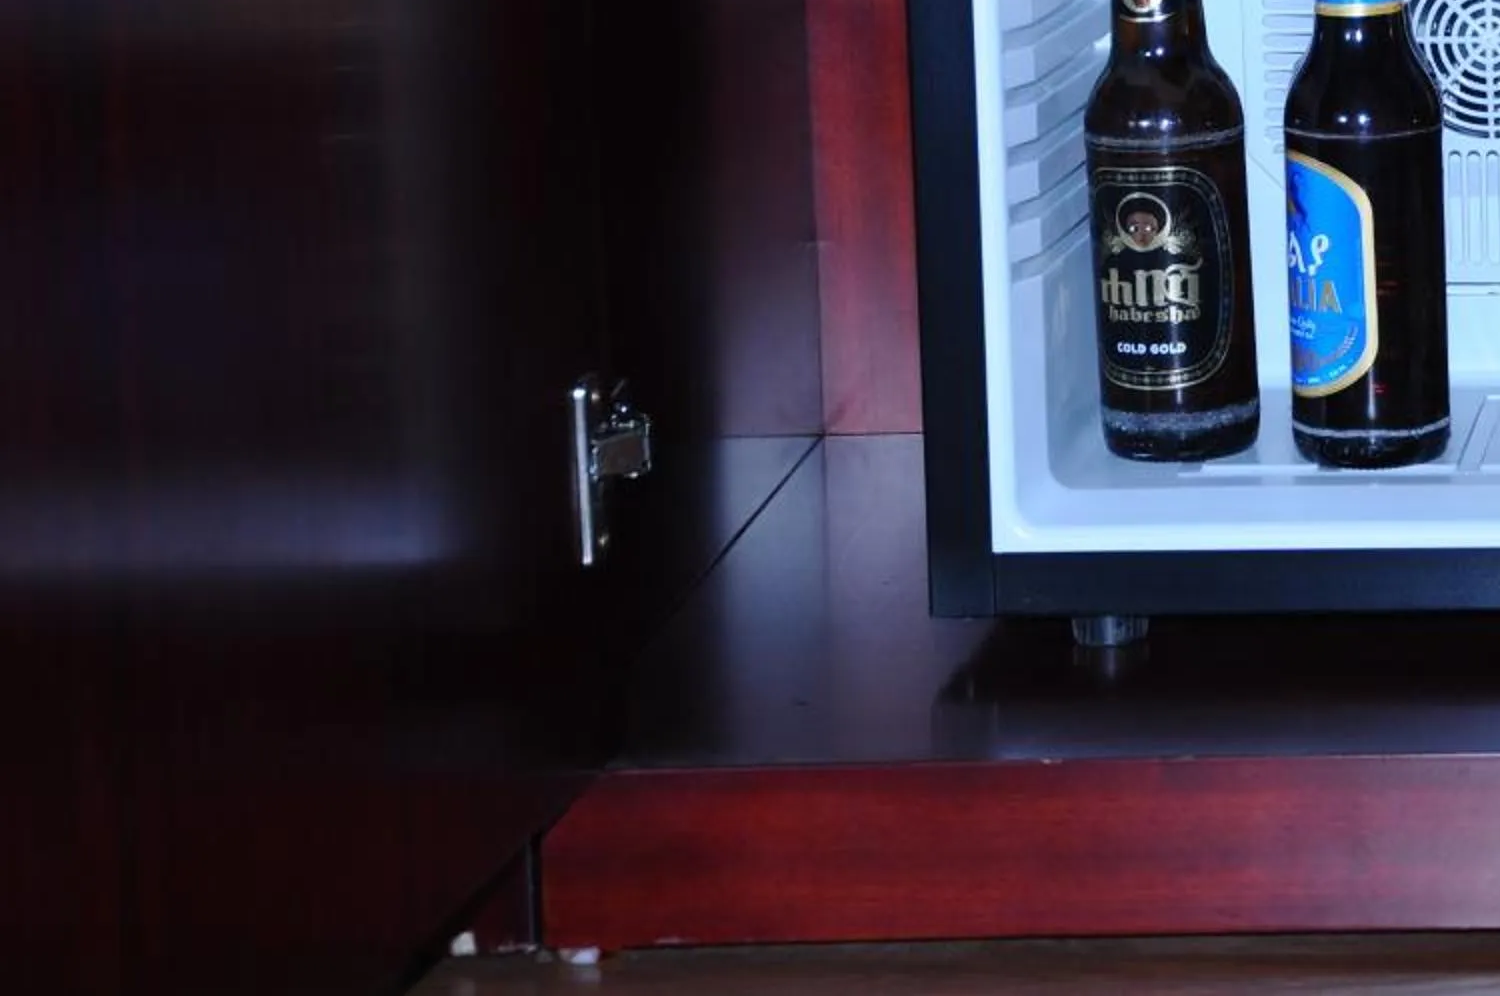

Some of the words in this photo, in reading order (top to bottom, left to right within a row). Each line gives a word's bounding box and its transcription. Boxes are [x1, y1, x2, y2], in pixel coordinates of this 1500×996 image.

[1109, 305, 1201, 325] habesha
[1117, 341, 1147, 355] COLD
[1149, 341, 1187, 355] GOLD
